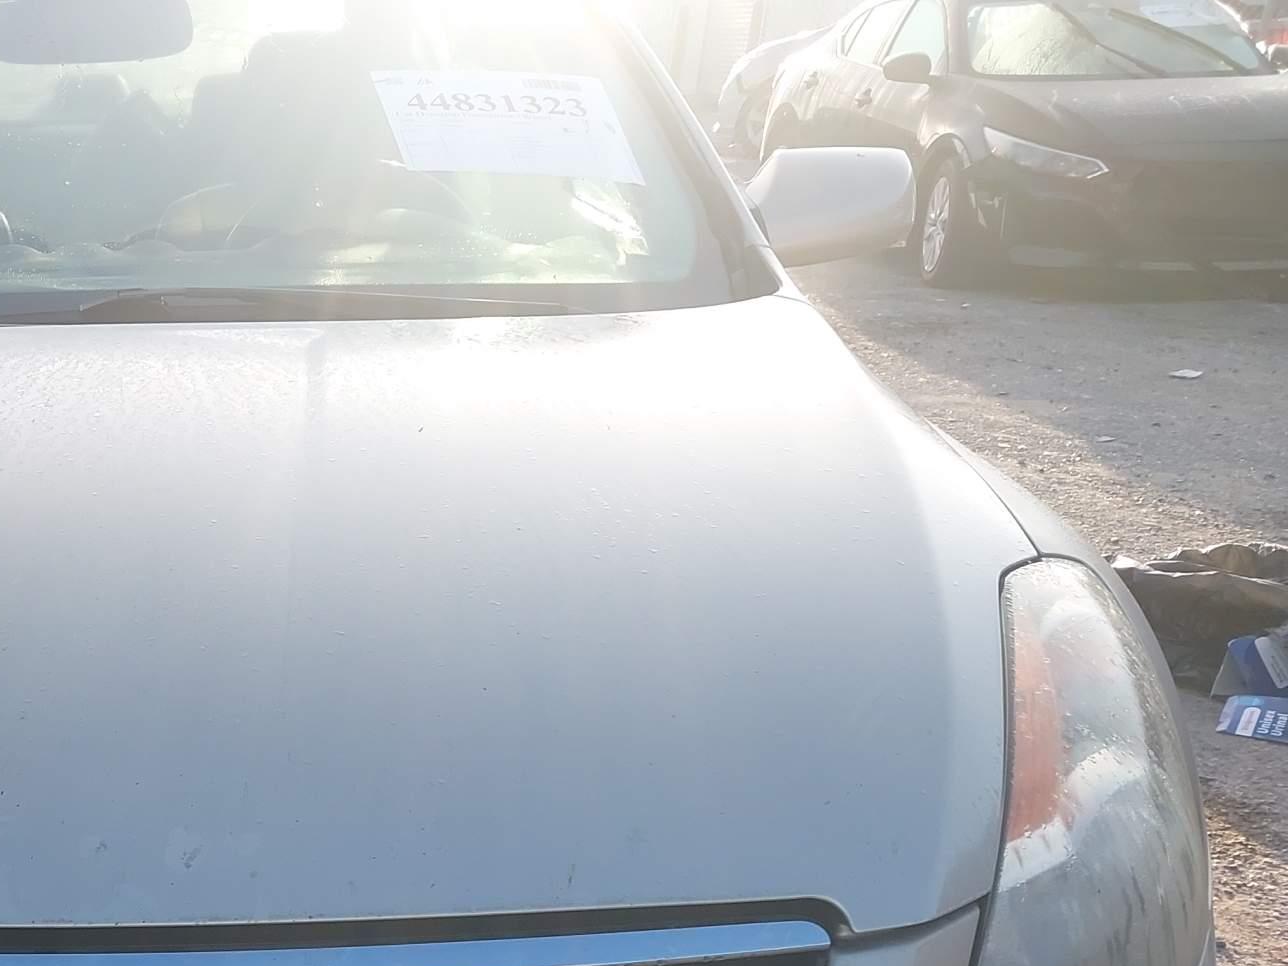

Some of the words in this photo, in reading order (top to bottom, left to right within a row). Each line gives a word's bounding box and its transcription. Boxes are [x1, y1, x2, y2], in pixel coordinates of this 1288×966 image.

[407, 91, 588, 119] 44831323
[1257, 710, 1277, 734] Unisex
[1270, 713, 1288, 737] Urinal
